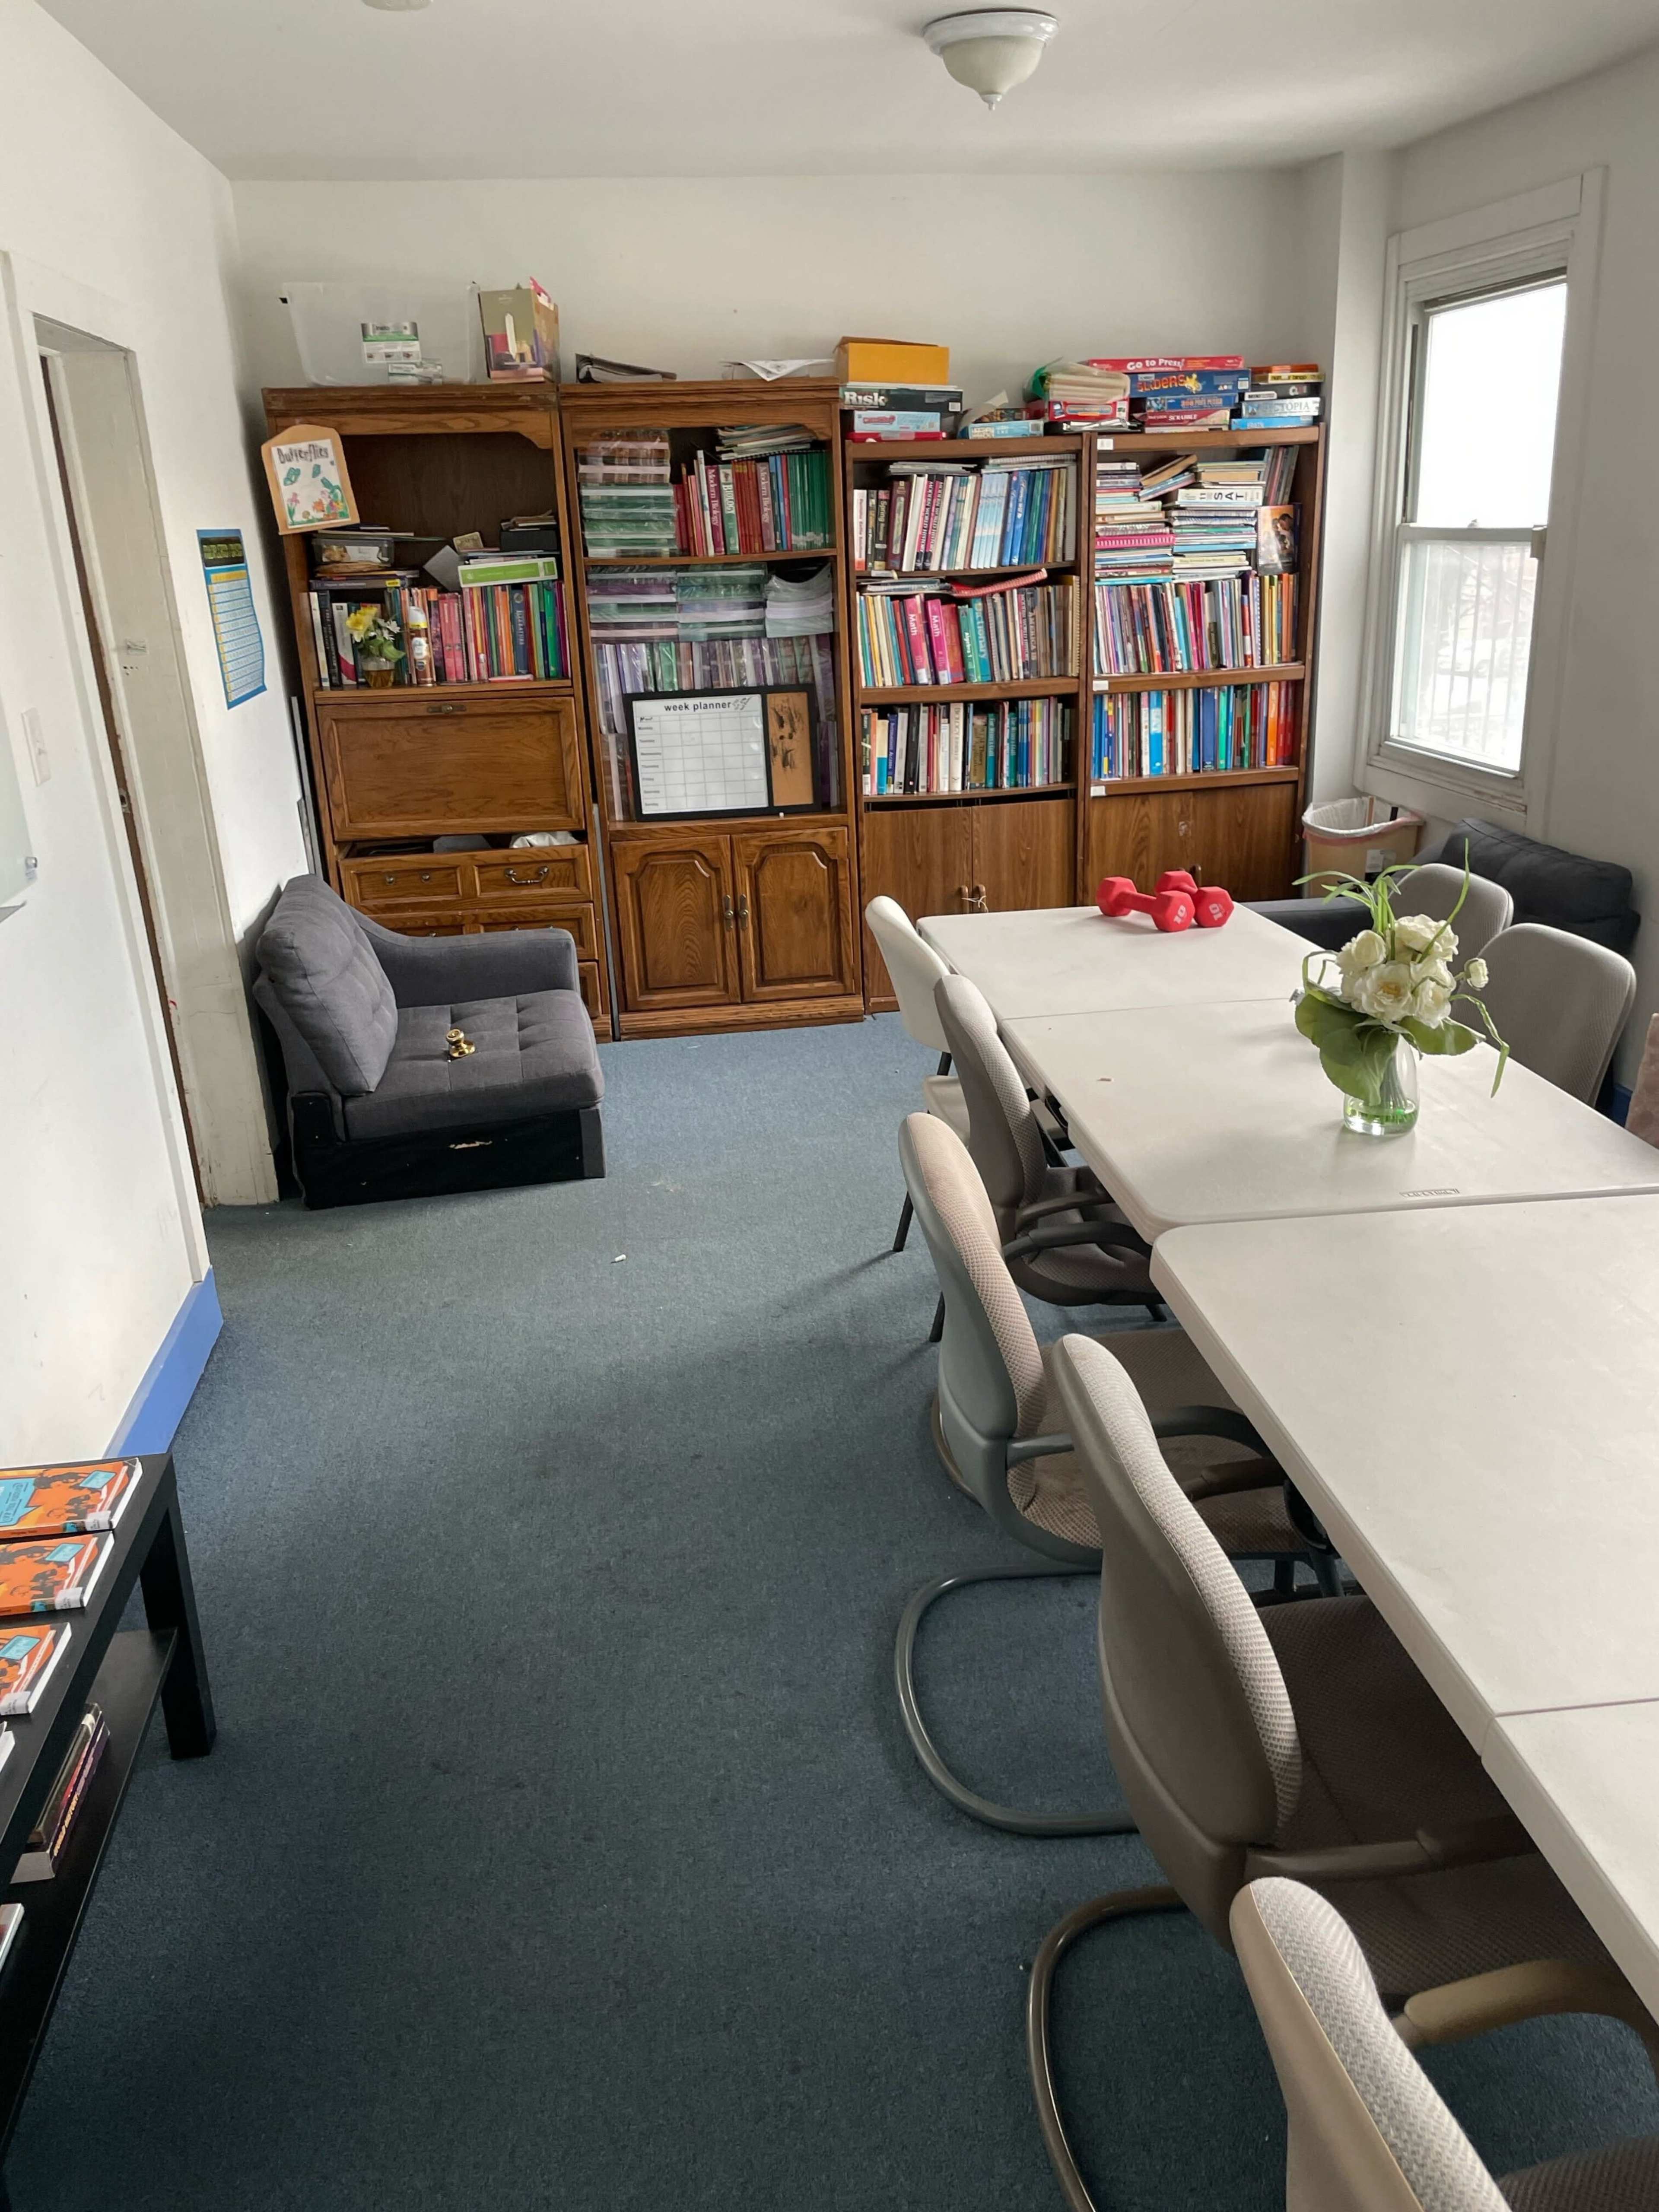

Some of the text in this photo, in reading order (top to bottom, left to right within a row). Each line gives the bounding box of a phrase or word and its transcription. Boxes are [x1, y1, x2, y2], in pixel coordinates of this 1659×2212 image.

[1127, 361, 1143, 370] Go
[844, 391, 887, 407] Risk
[878, 501, 887, 522] Spring
[909, 614, 918, 636] Math
[931, 615, 941, 637] Math
[974, 603, 988, 659] Dictionary
[964, 632, 973, 655] Algebra
[664, 700, 731, 714] week planner
[1173, 905, 1186, 924] 10
